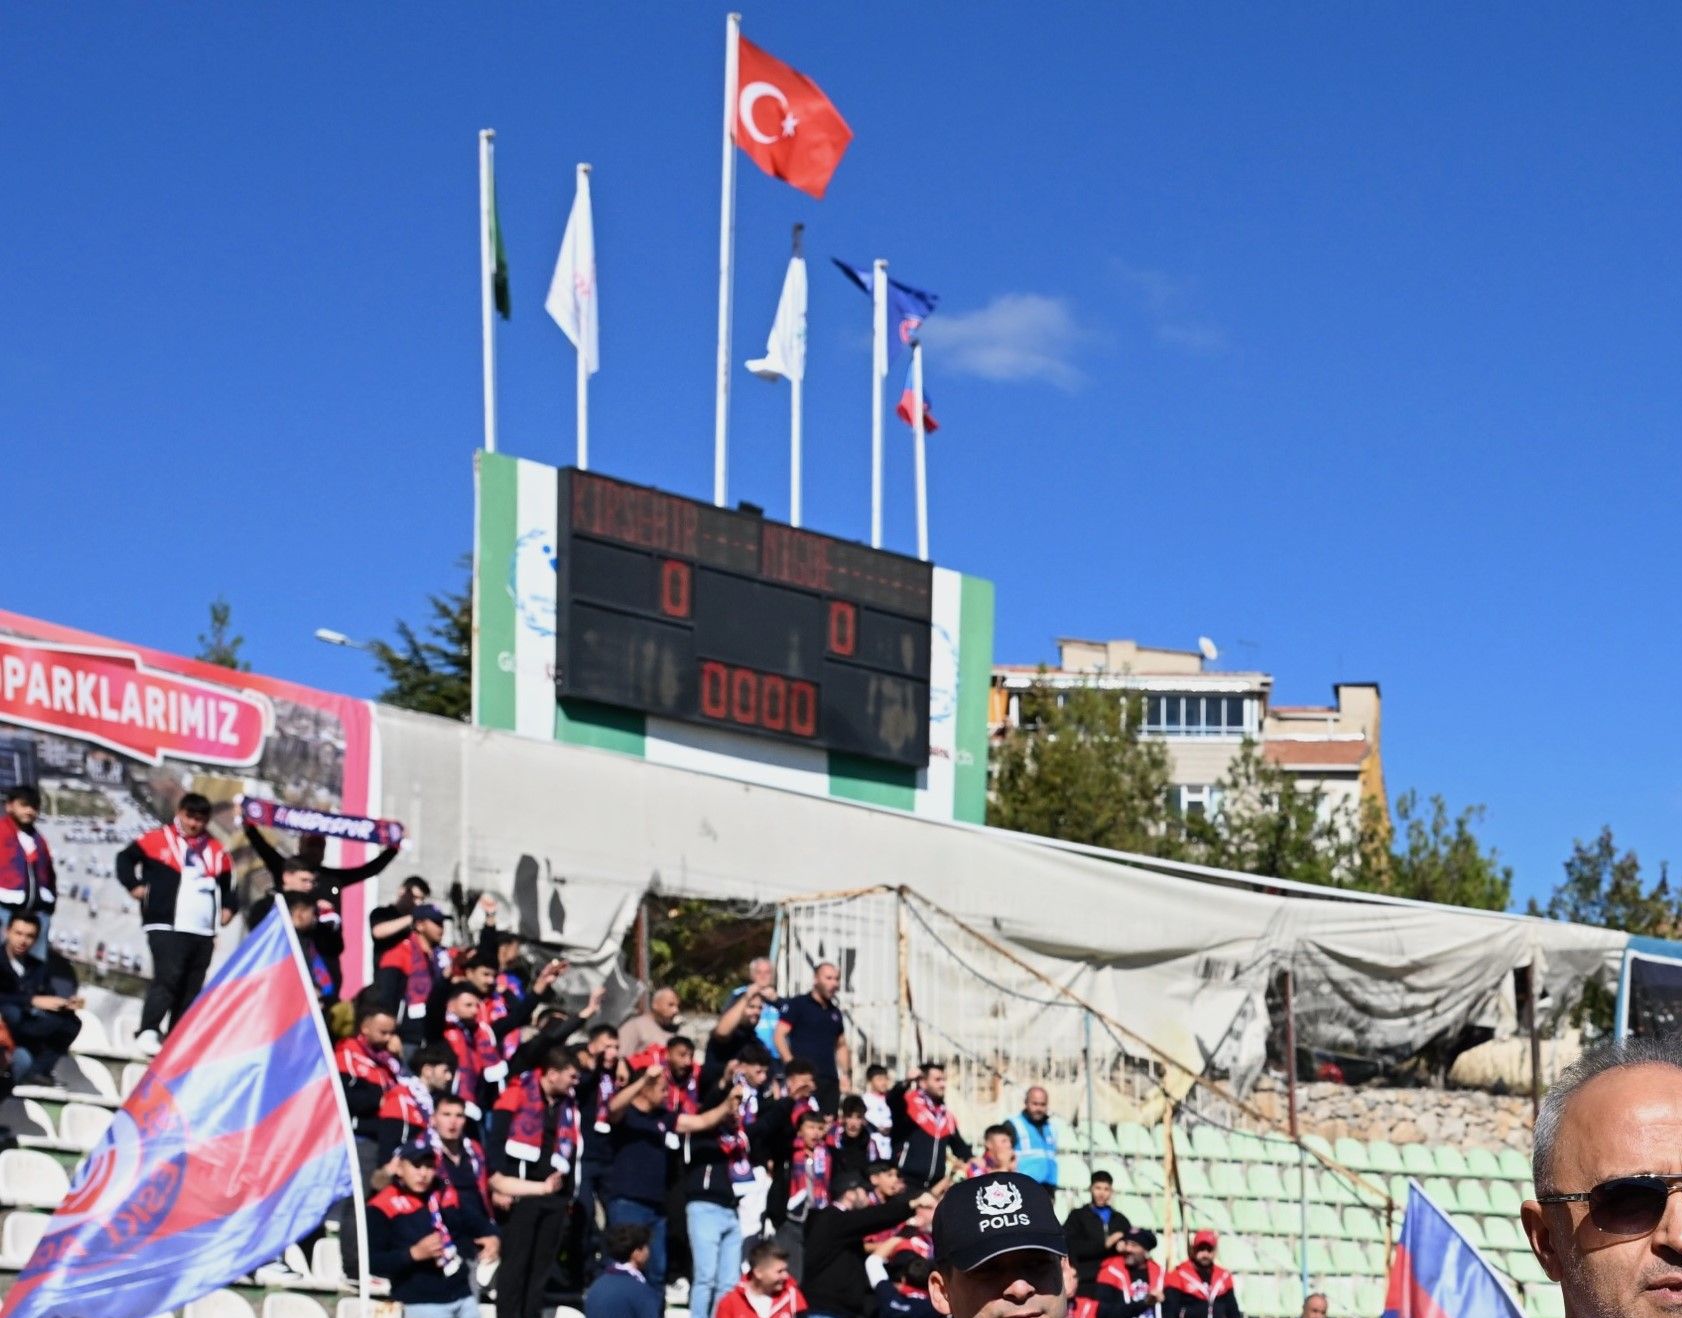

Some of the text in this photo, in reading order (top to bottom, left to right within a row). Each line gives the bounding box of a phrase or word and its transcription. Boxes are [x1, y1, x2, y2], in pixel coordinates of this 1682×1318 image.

[661, 559, 856, 658] 0 0
[0, 654, 240, 746] PARKLARIMIZ
